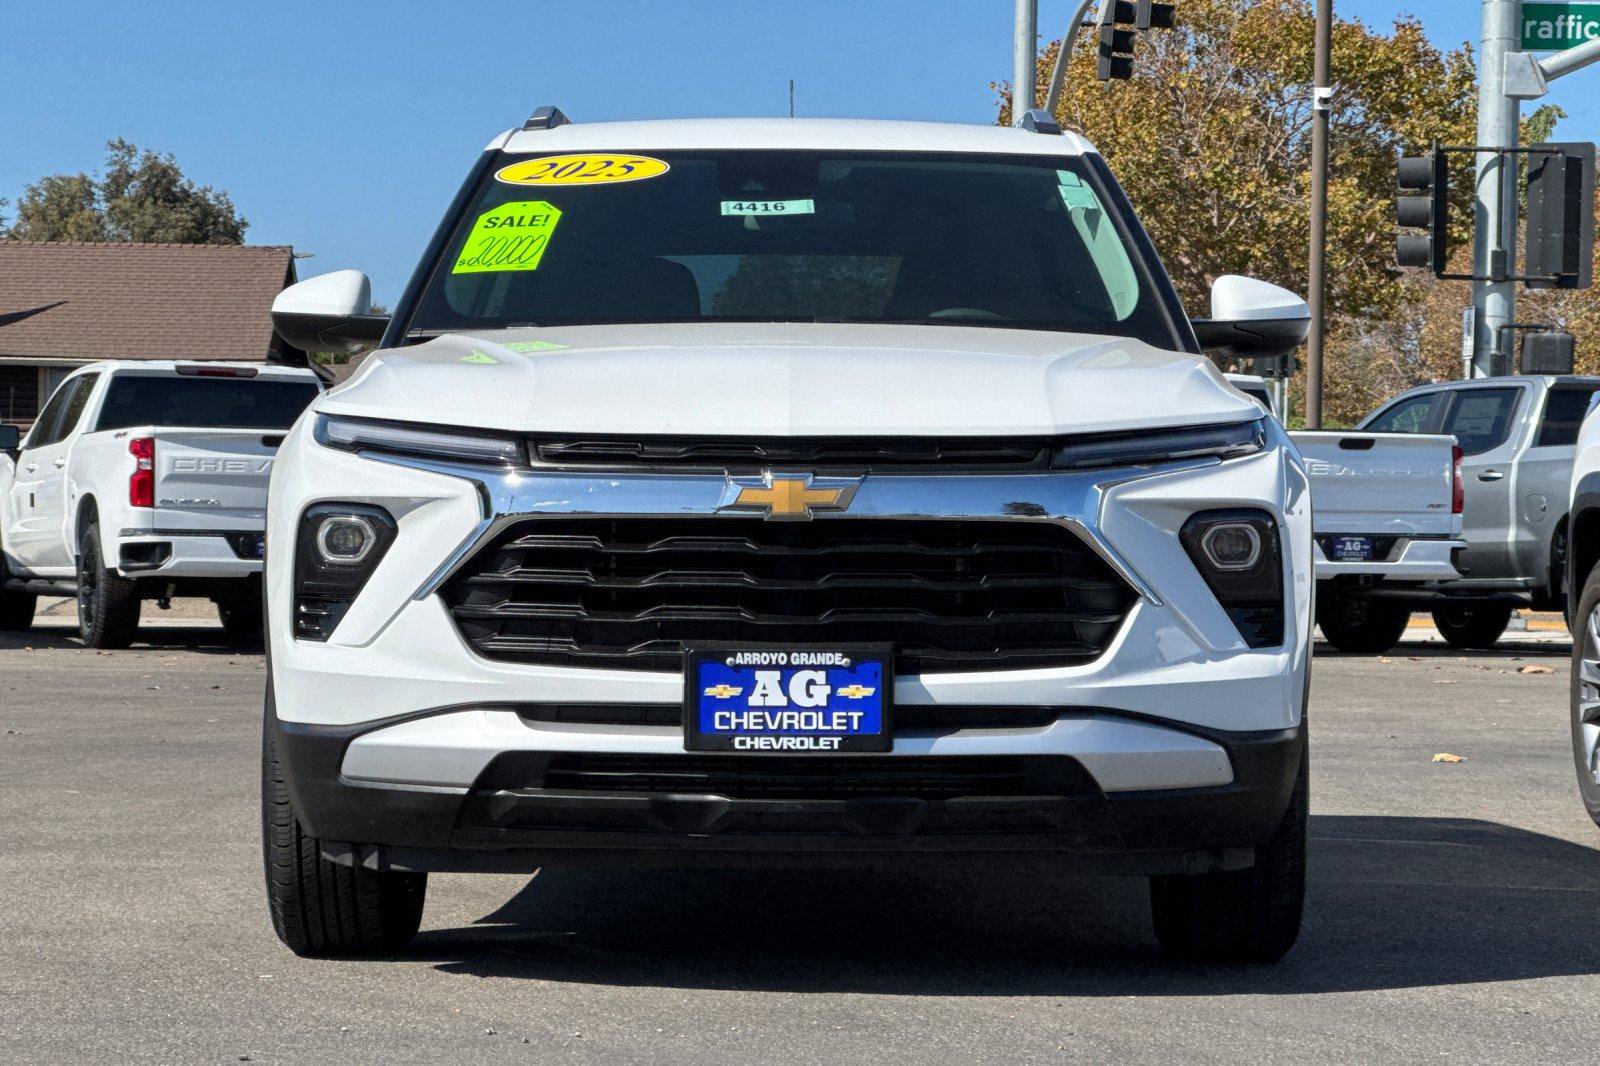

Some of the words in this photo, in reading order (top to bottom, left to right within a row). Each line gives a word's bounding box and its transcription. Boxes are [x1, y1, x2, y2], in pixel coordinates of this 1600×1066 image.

[1522, 14, 1600, 40] raffic
[521, 160, 646, 181] 2025
[732, 202, 786, 212] 4416
[483, 214, 551, 229] SALE!
[1344, 541, 1362, 551] AG
[735, 652, 787, 665] ARROYO
[790, 652, 843, 665] GRANDE
[748, 669, 831, 707] AG
[714, 711, 865, 730] CHEVROLET
[733, 736, 843, 750] CHEVROLET
